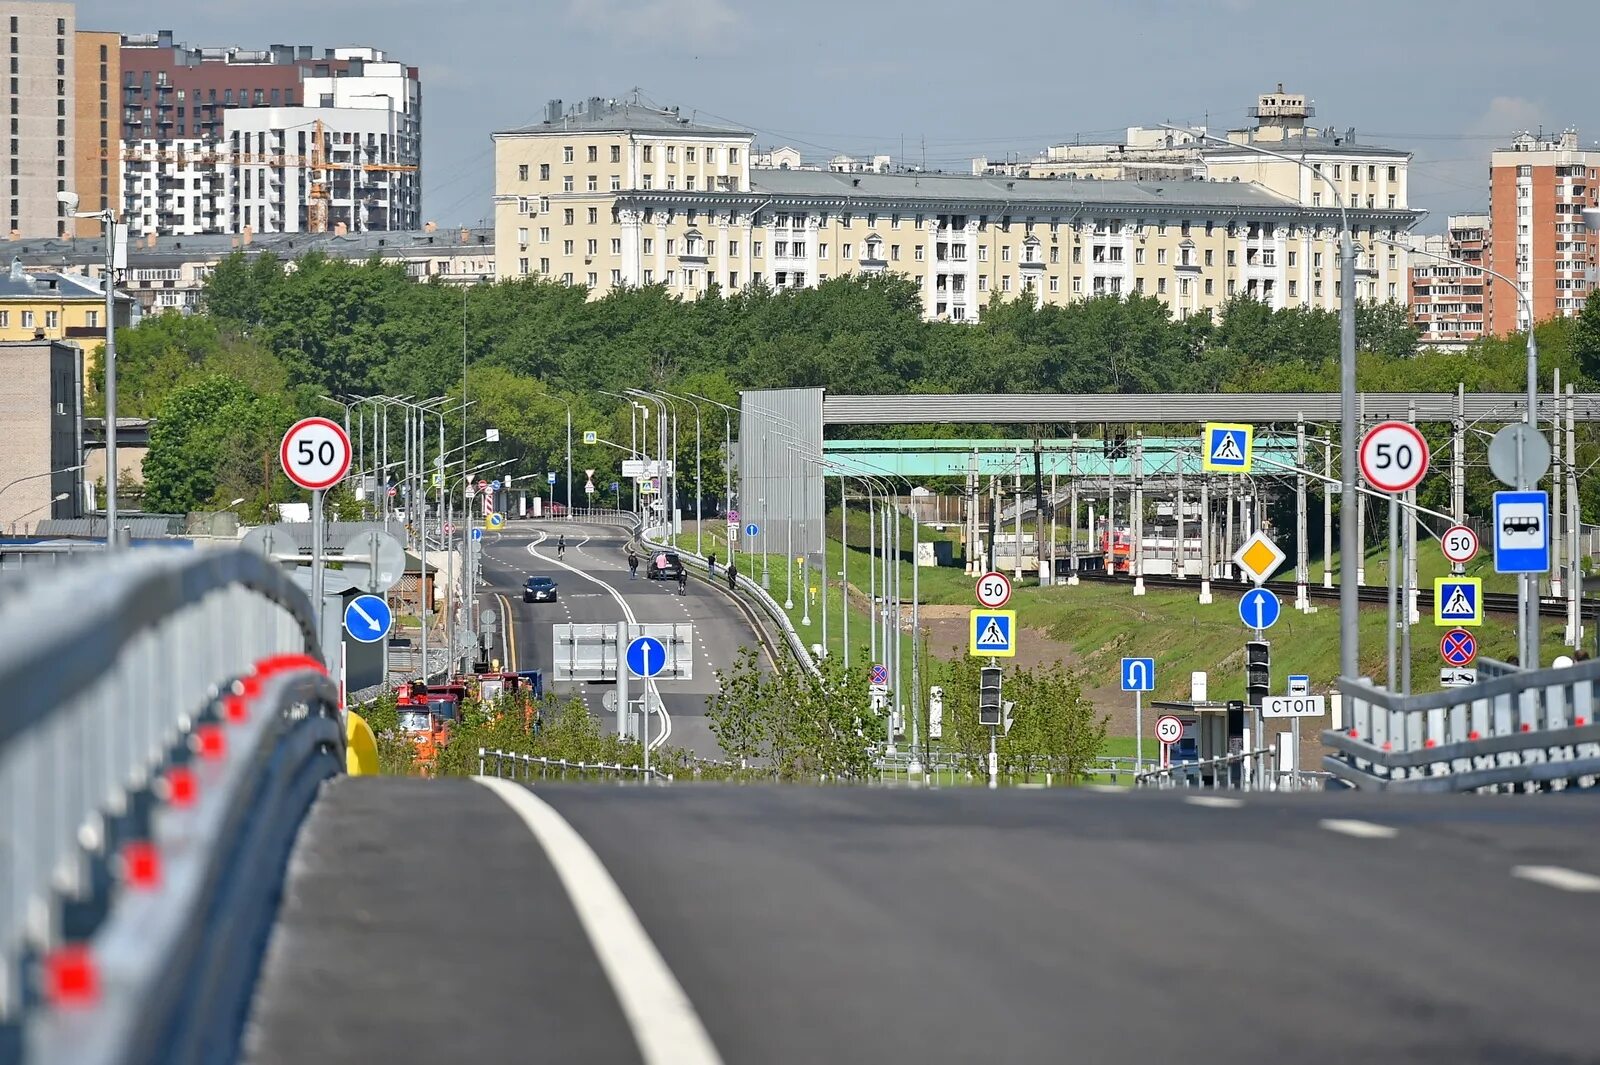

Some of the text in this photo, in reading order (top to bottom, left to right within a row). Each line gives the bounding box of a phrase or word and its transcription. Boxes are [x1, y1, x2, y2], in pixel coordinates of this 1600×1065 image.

[298, 440, 335, 466] 50
[1376, 443, 1412, 470] 50
[1450, 537, 1470, 551] 50
[984, 583, 1003, 597] 50
[1272, 699, 1315, 713] СТОП
[1161, 724, 1177, 735] 50
